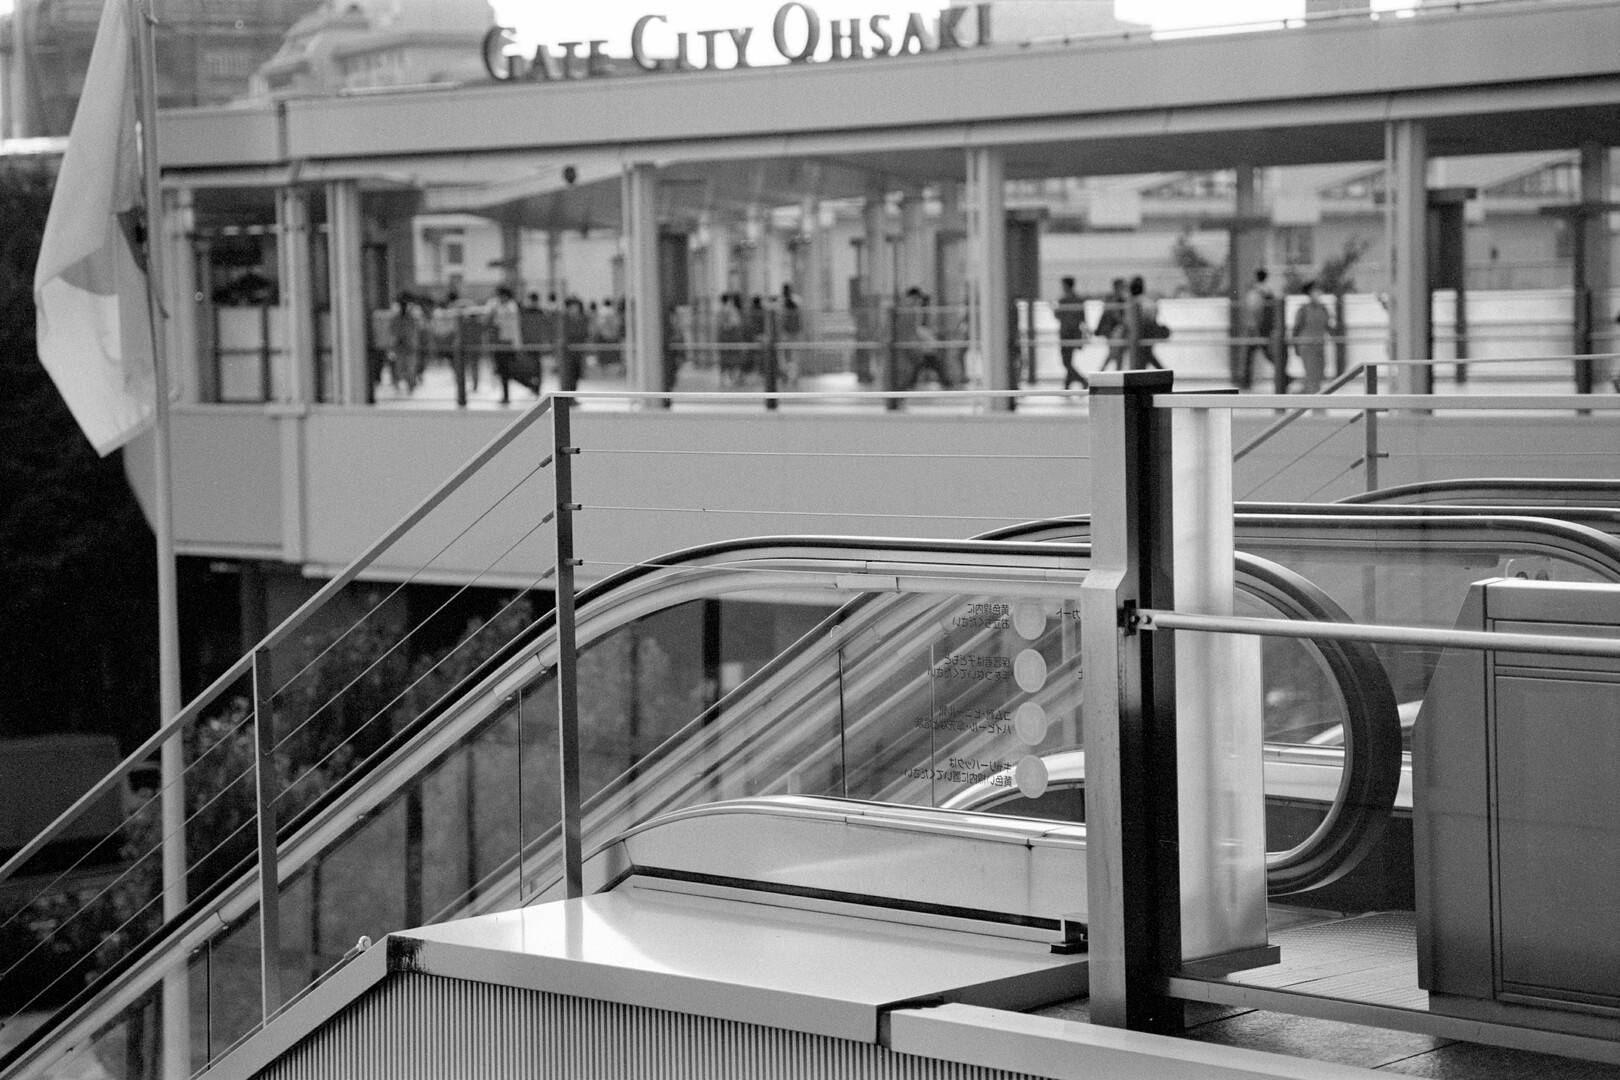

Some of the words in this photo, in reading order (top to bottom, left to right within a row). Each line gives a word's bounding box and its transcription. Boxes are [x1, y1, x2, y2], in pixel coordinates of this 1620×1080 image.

[482, 26, 608, 81] GATE
[631, 14, 753, 70] CITY
[773, 1, 992, 64] OHSAKI
